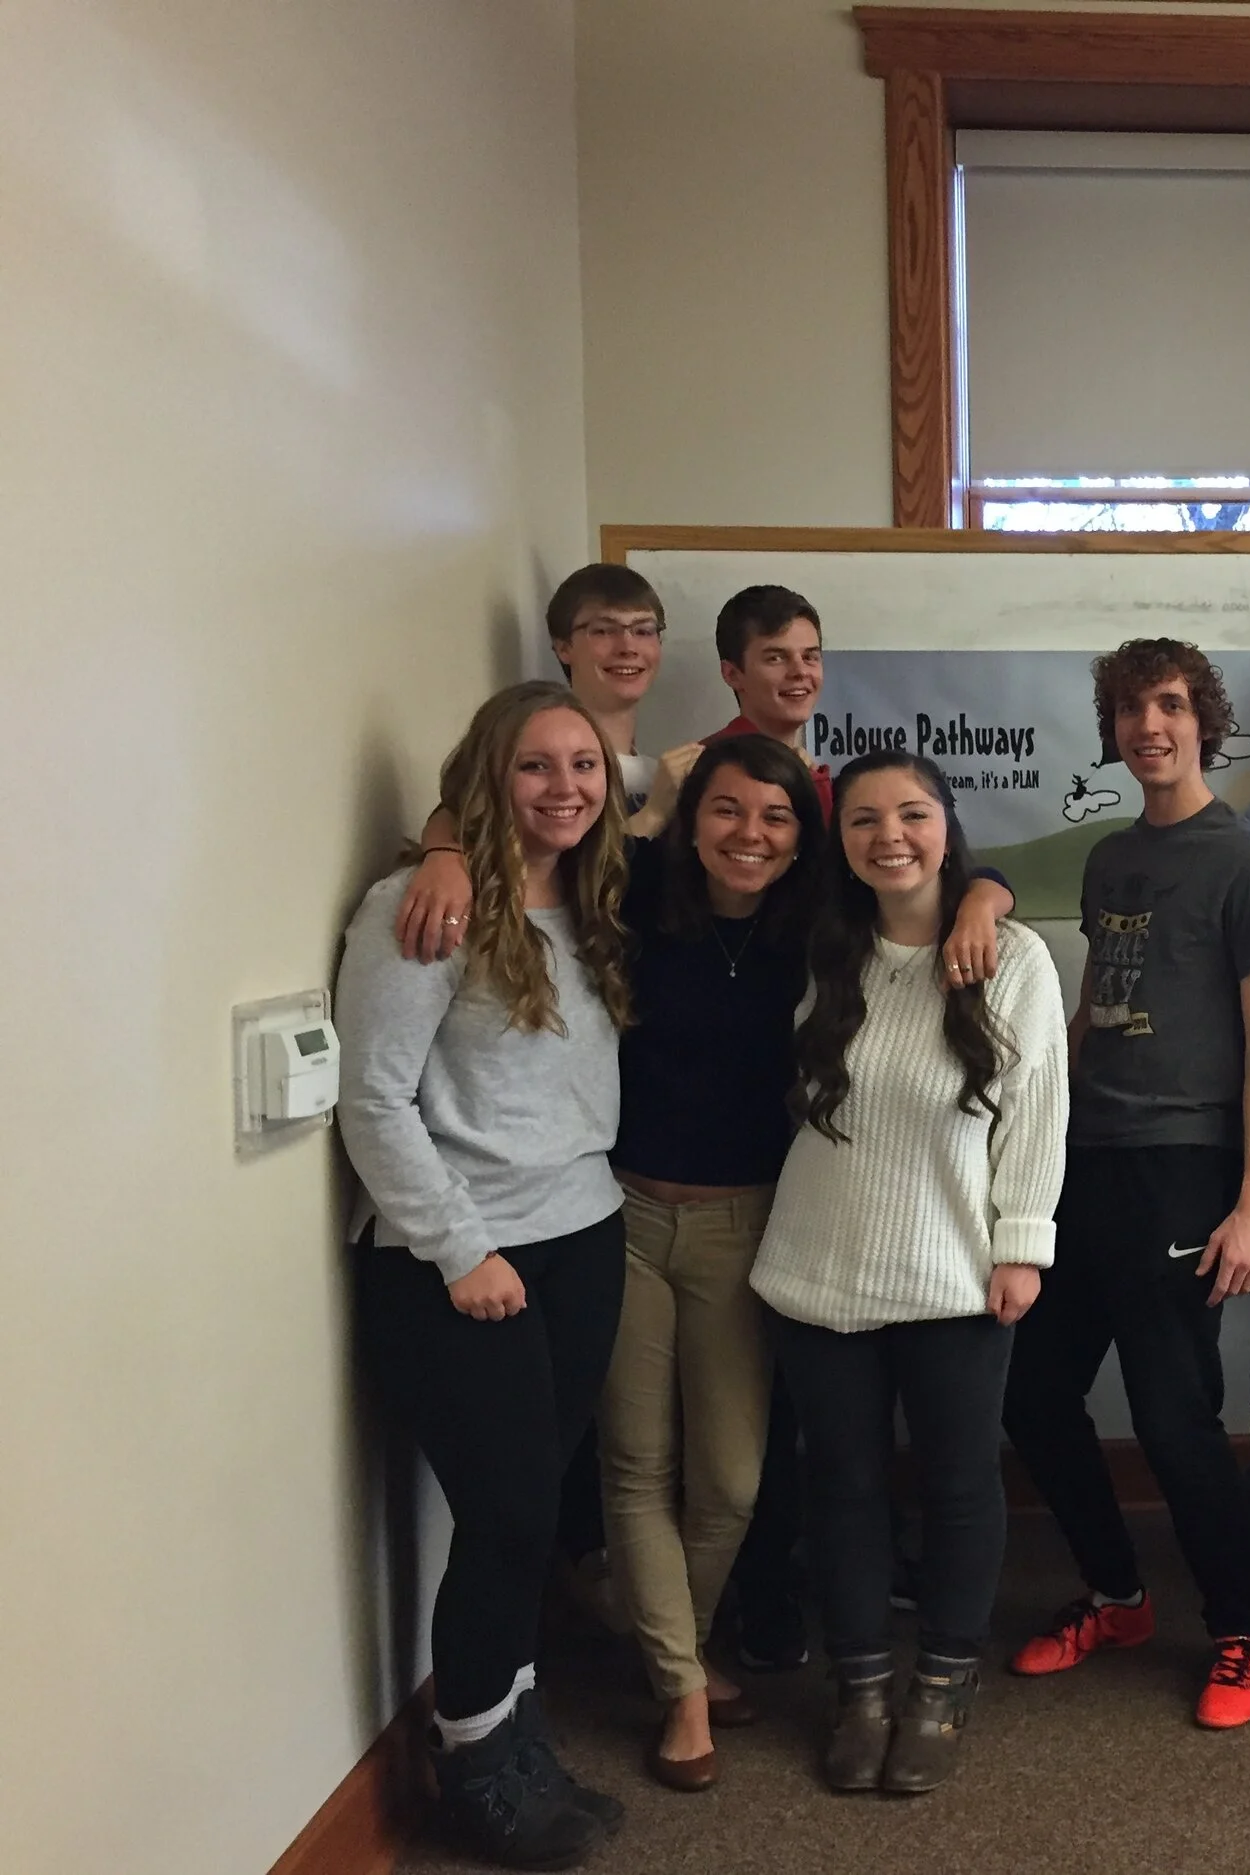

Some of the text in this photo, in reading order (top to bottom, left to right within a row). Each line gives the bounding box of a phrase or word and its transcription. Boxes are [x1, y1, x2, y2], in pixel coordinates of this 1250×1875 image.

[813, 712, 1036, 763] Palouse Pathways
[942, 769, 1040, 792] ream, it's a PLAN
